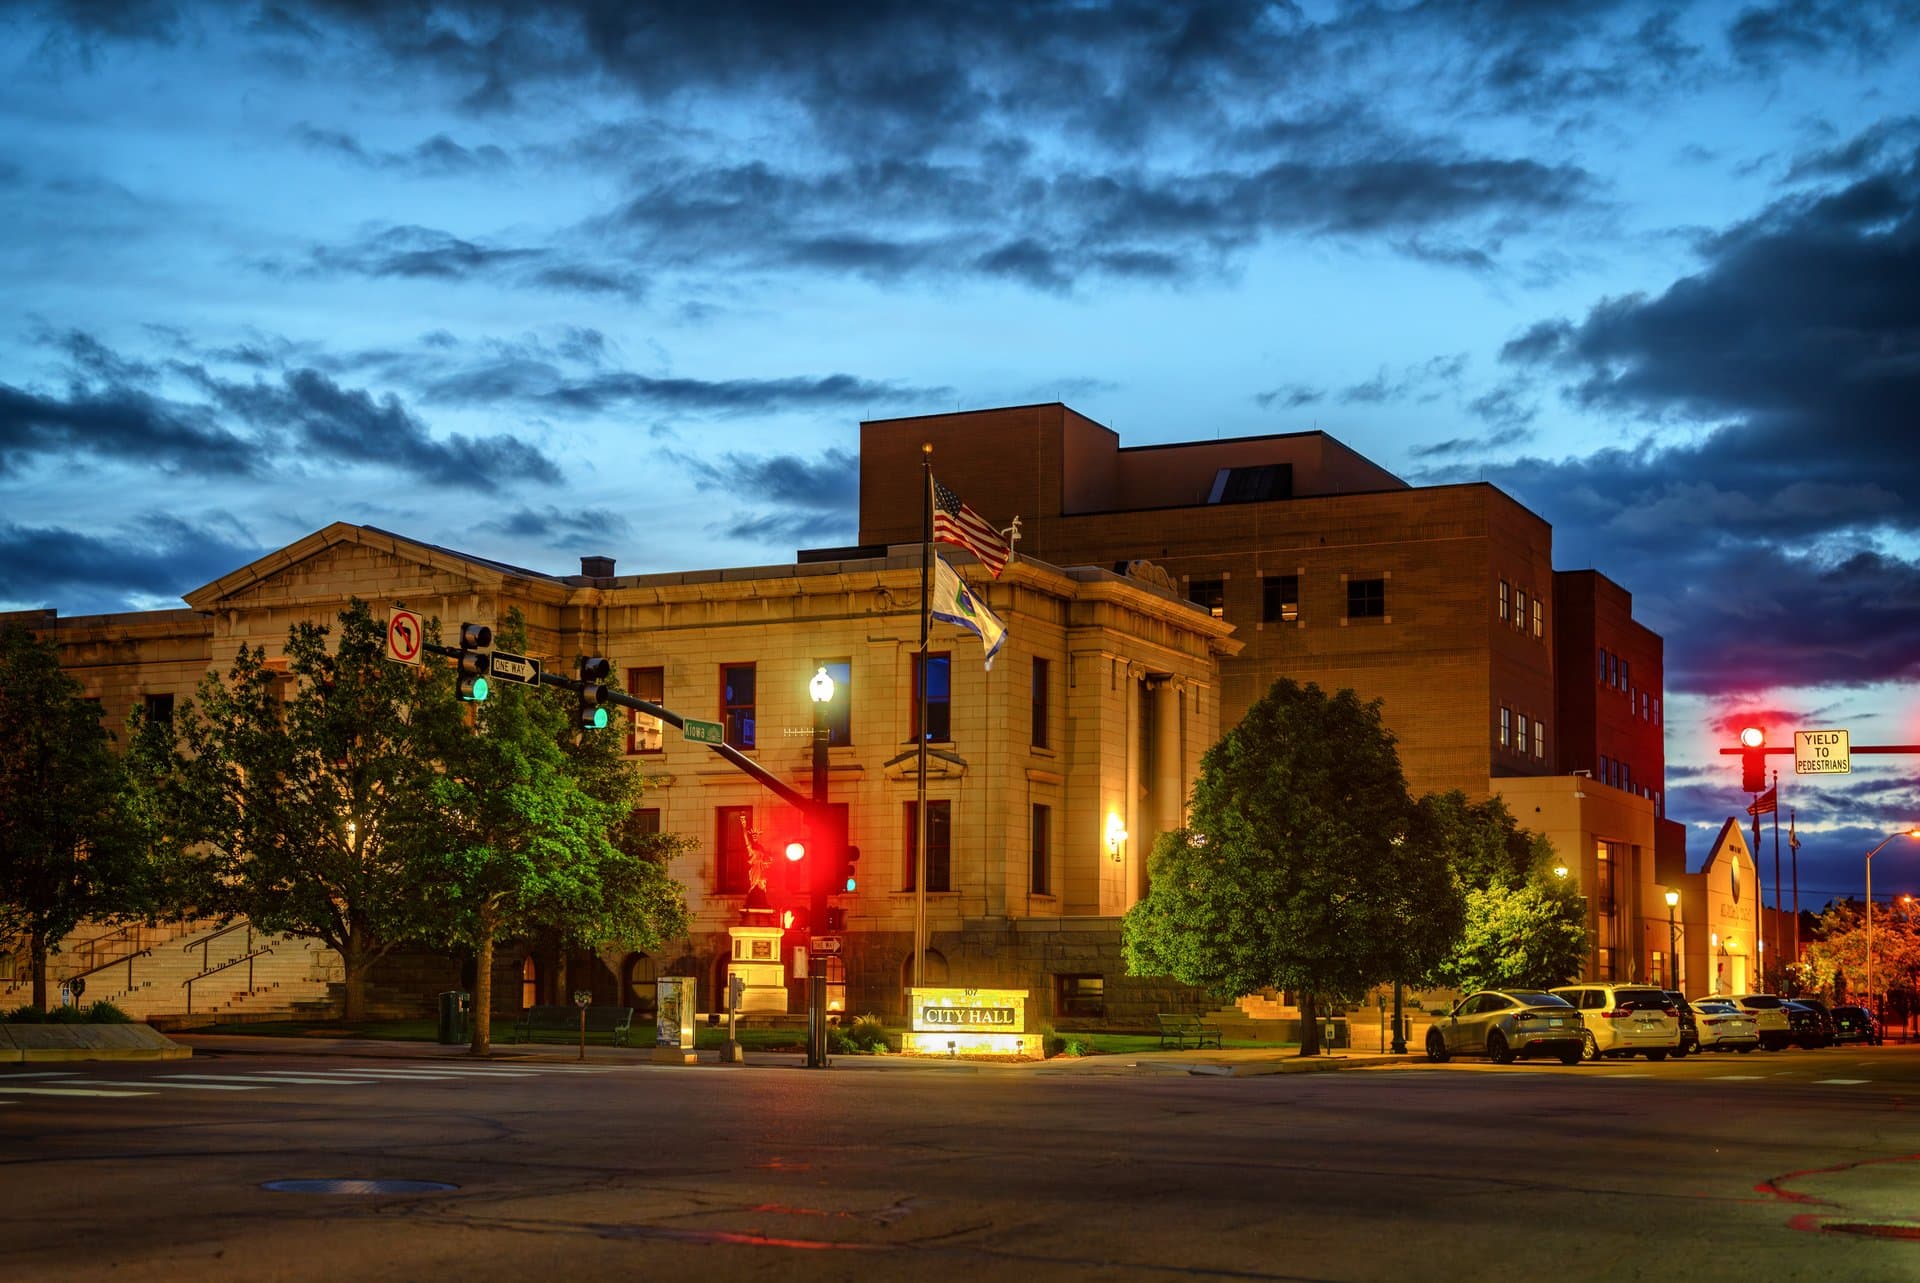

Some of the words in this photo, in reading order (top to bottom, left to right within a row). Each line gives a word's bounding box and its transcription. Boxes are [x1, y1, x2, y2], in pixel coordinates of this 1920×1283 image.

[495, 660, 509, 671] ONE
[511, 663, 525, 675] WAY
[685, 722, 705, 738] Kiowa
[1804, 734, 1839, 745] YIELD
[1814, 747, 1829, 758] TO
[1798, 760, 1848, 771] PEDESTRIANS
[965, 988, 978, 997] 107
[926, 1009, 965, 1023] CITY
[969, 1010, 1013, 1024] HALL
